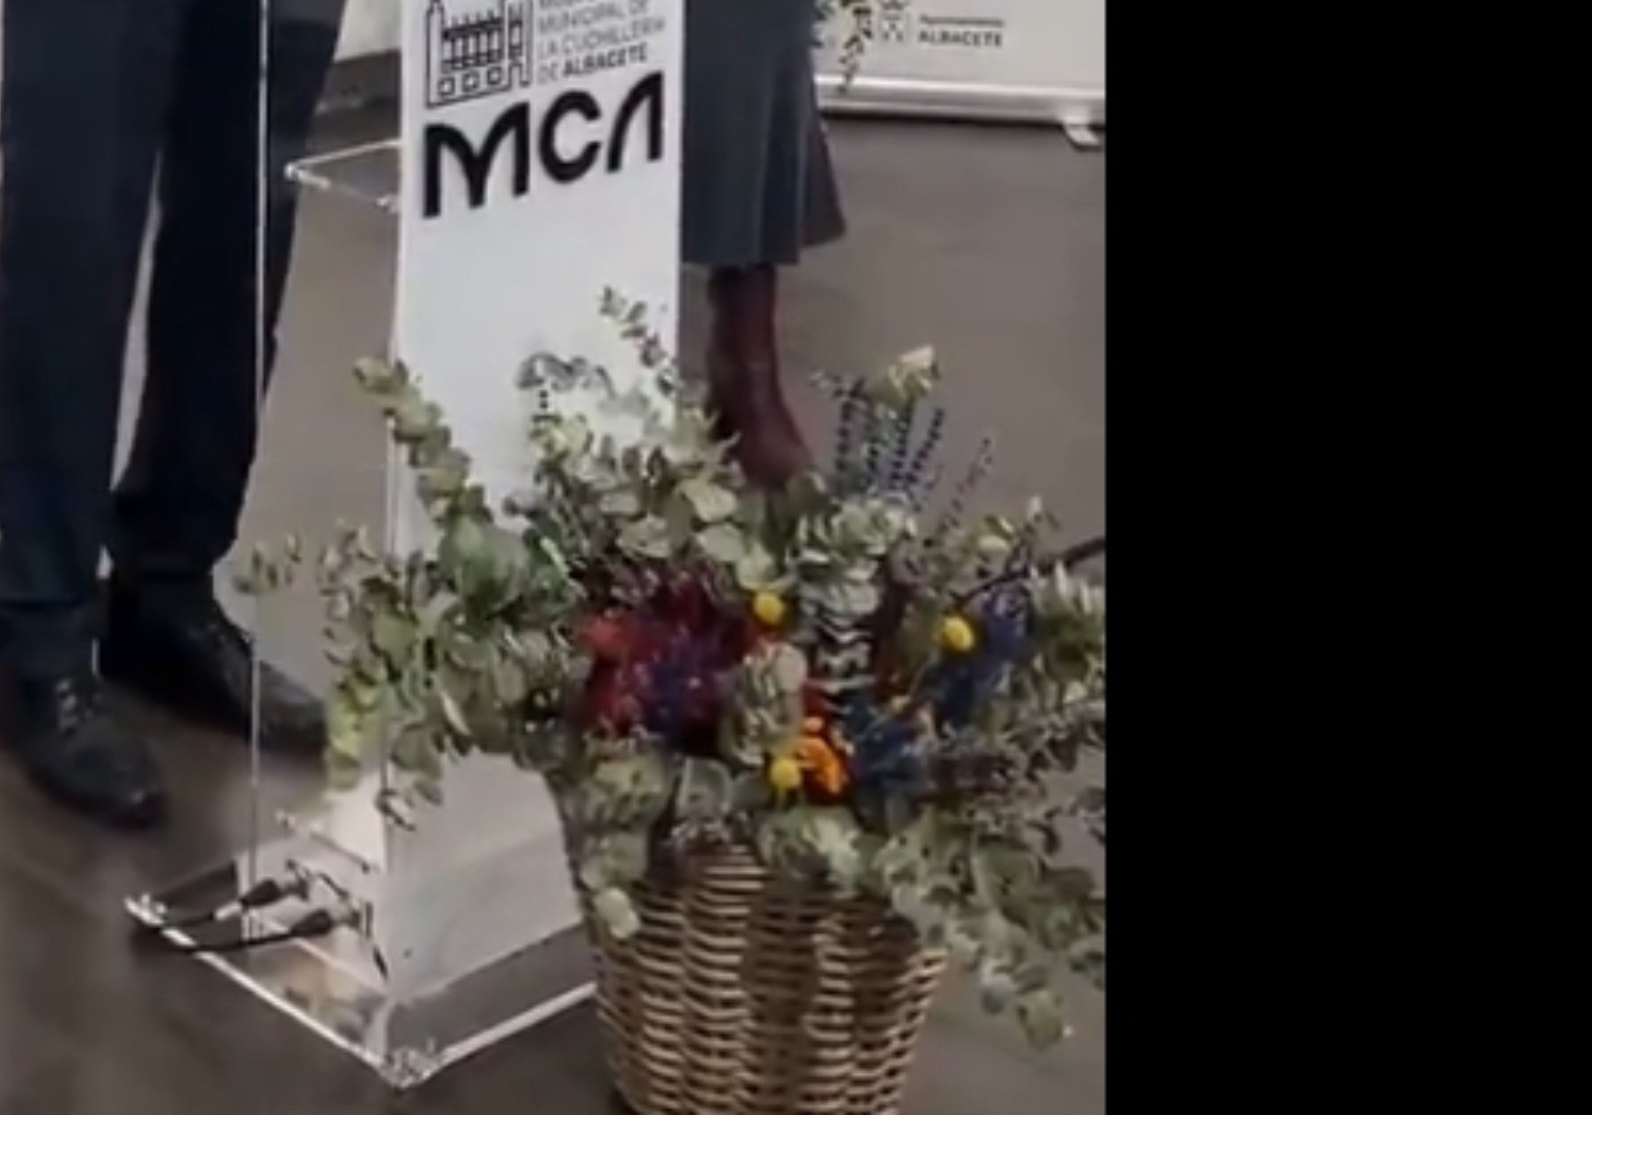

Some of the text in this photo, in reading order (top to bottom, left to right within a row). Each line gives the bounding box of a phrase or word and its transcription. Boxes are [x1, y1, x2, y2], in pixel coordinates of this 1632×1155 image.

[918, 29, 1003, 47] ALBACETE
[563, 41, 647, 77] ALBACETE
[422, 69, 664, 219] MCA
